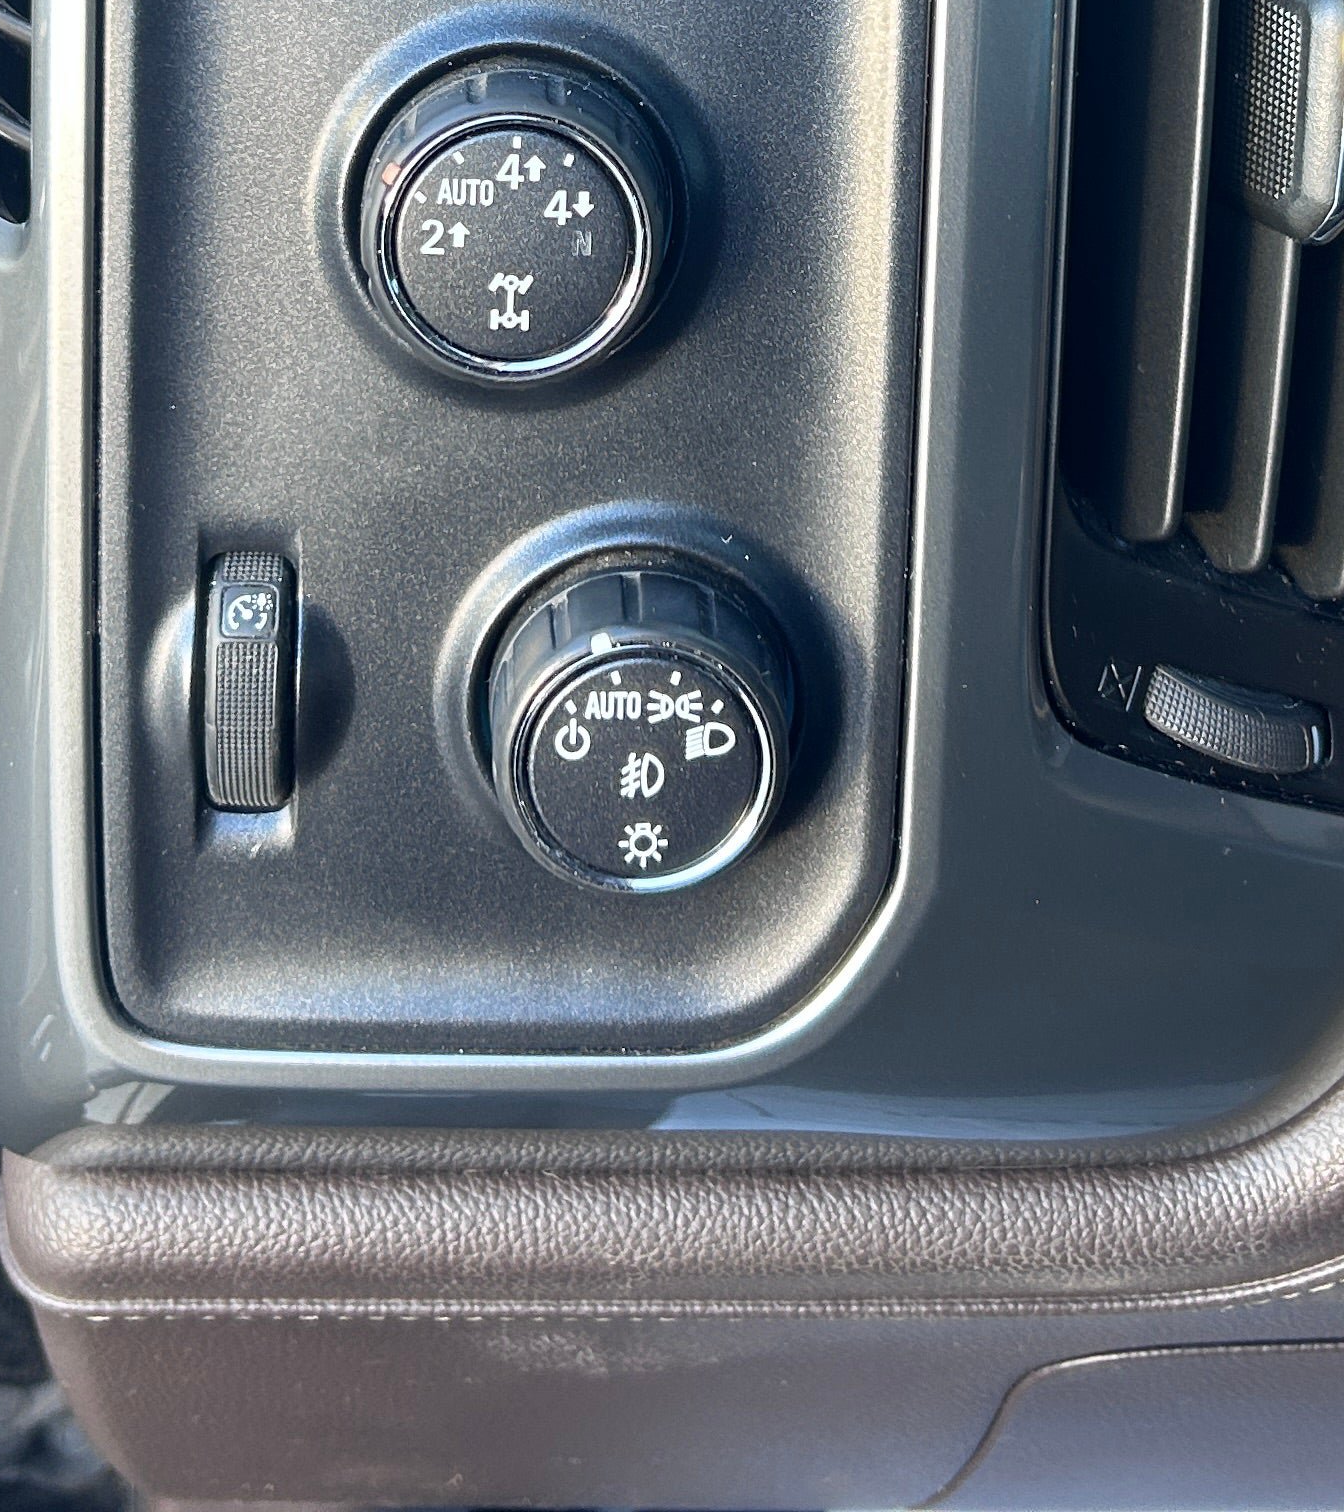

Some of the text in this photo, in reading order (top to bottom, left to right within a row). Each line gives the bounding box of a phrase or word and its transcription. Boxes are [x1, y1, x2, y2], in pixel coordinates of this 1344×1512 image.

[496, 153, 525, 191] 4
[436, 177, 495, 208] AUTO
[543, 189, 573, 226] 4
[419, 218, 446, 256] 2
[571, 230, 593, 257] N
[584, 690, 642, 721] AUTO
